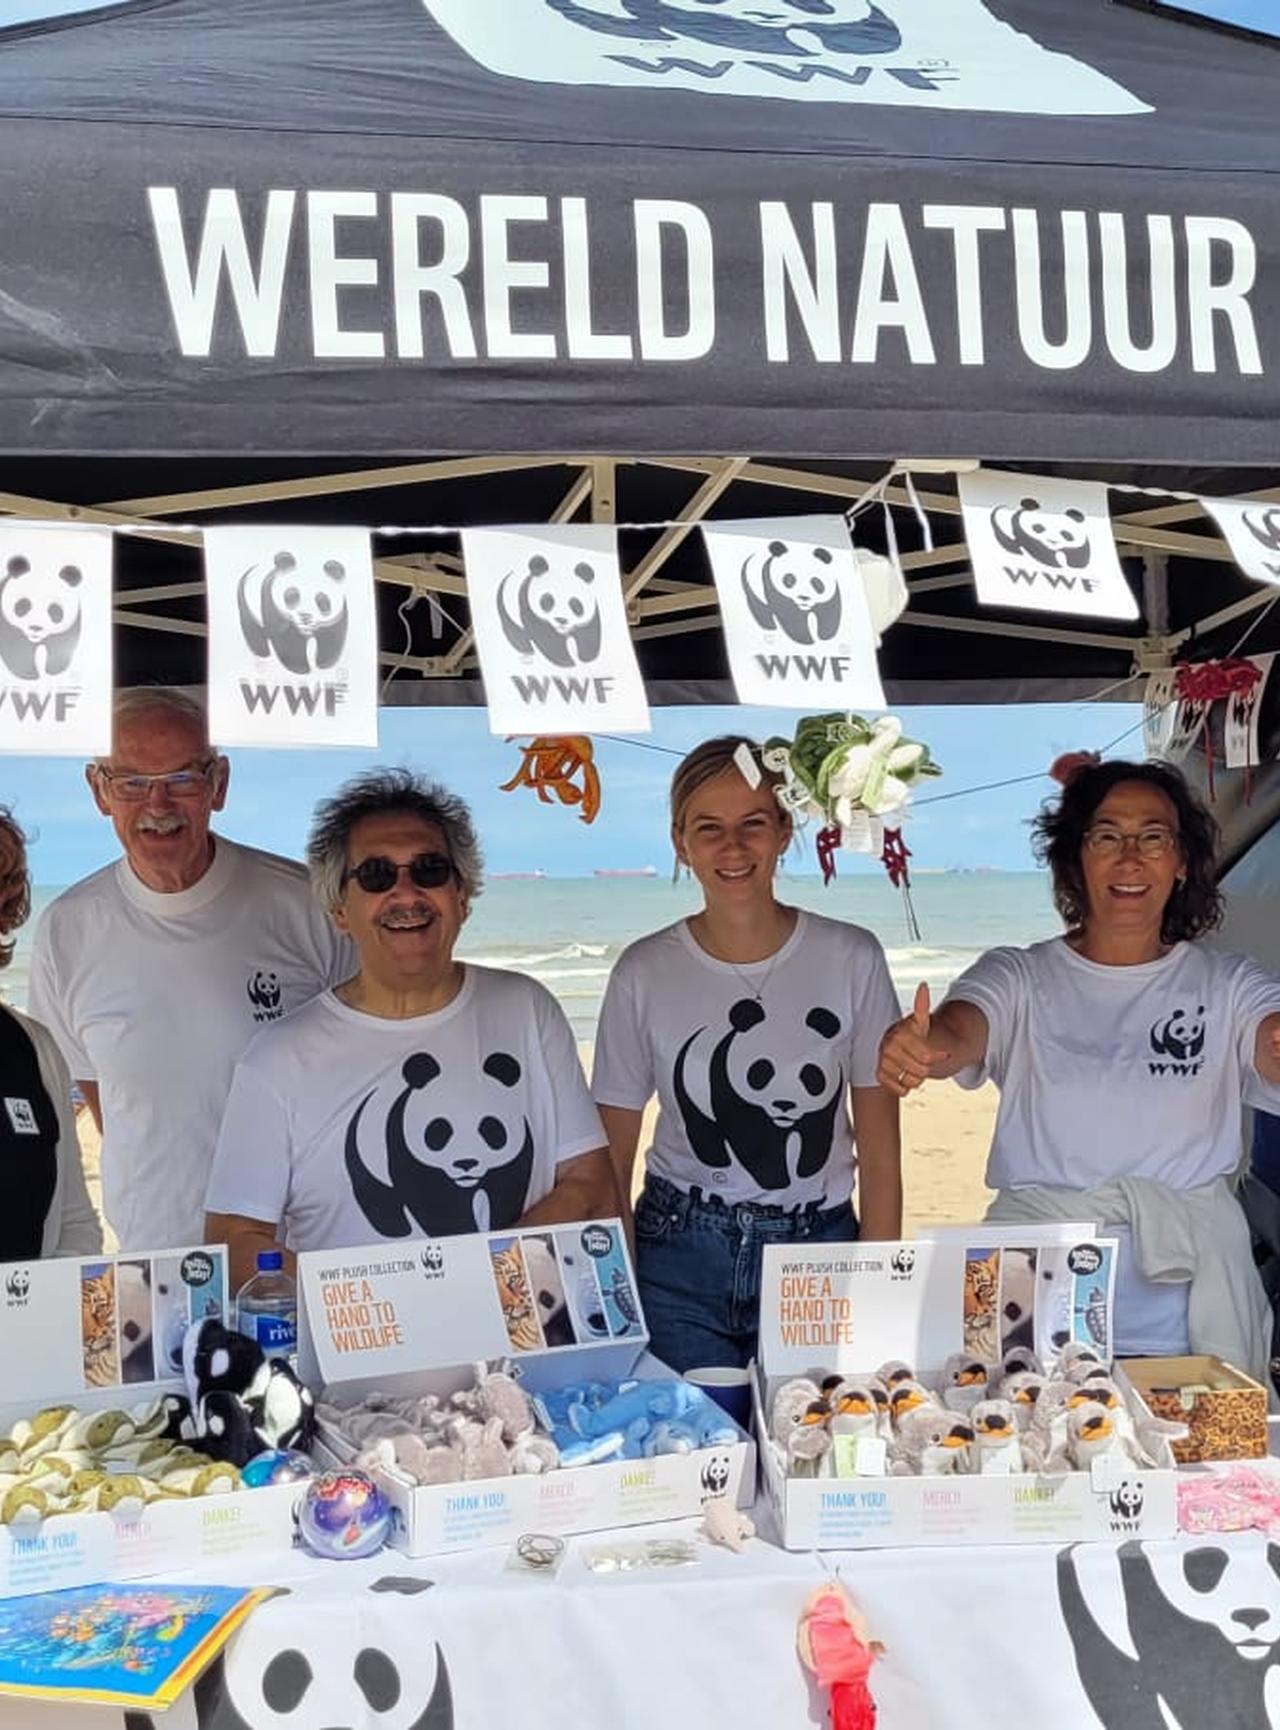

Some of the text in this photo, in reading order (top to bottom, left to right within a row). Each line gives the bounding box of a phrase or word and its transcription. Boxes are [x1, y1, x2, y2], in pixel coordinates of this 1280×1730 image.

[603, 53, 961, 91] WWF
[147, 186, 714, 362] WERELD
[759, 200, 1260, 375] NATUUR
[1003, 565, 1102, 593] WWF
[754, 654, 852, 682] WWF
[241, 681, 350, 718] WWF
[510, 675, 617, 705] WWF
[253, 1008, 286, 1022] WWF
[1148, 1060, 1204, 1076] WWF
[319, 1260, 416, 1281] WWF PLUSH COLLECTION
[781, 1260, 884, 1274] WWF PLUSH COLLECTION
[322, 1279, 373, 1307] GIVE A
[781, 1275, 832, 1299] GIVE A
[326, 1301, 396, 1330] HAND TO
[780, 1298, 851, 1322] HAND TO
[331, 1324, 405, 1353] WILDLIFE
[780, 1323, 854, 1346] WILDLIFE
[445, 1495, 480, 1513] THANK
[820, 1491, 886, 1509] THANK YOU!
[1109, 1520, 1144, 1532] WWF
[12, 1534, 49, 1556] THANK
